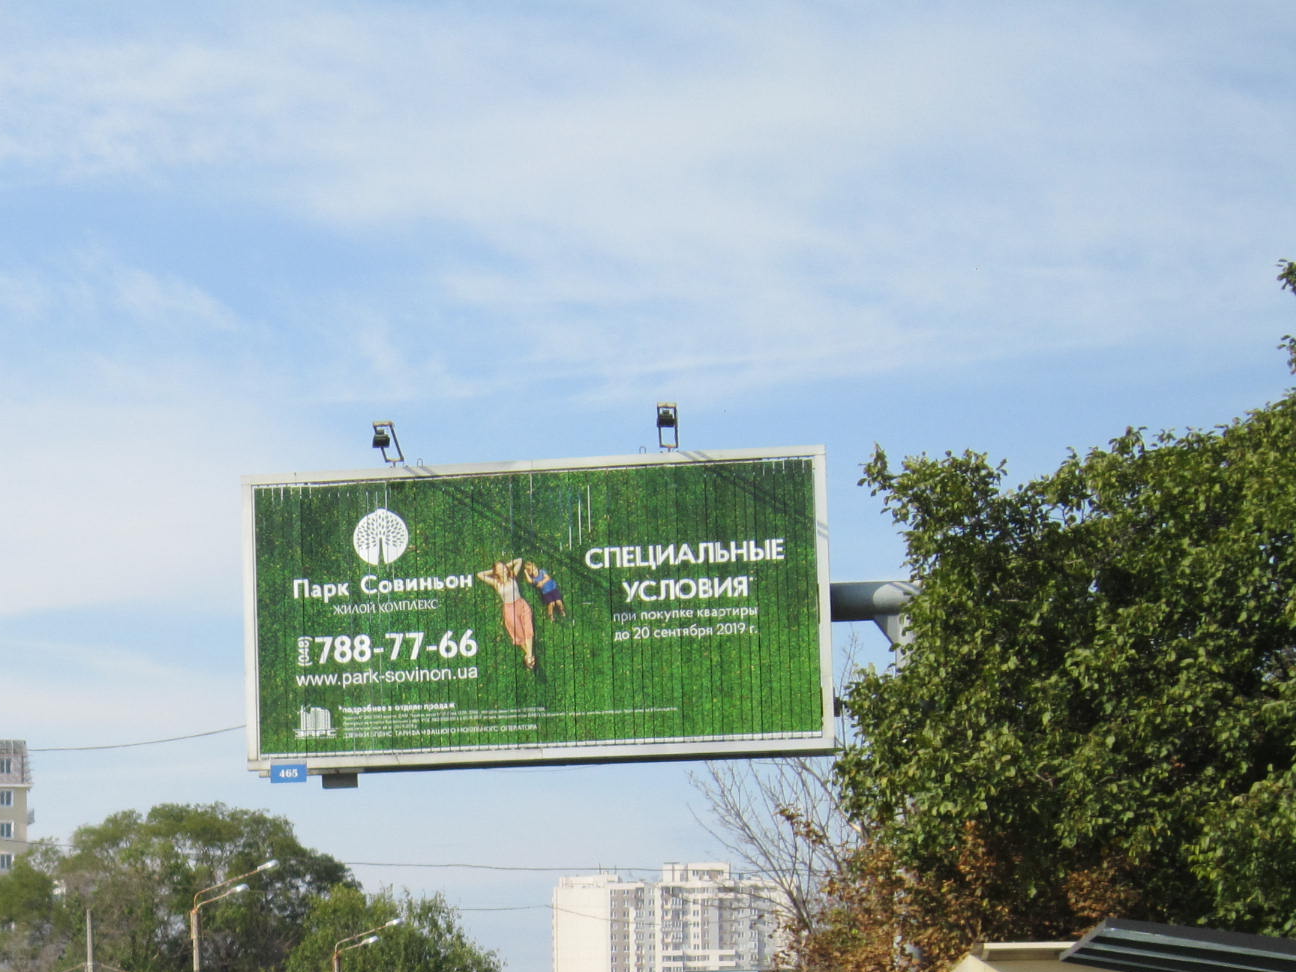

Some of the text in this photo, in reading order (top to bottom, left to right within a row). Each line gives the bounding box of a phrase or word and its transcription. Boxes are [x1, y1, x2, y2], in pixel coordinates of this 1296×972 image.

[585, 538, 785, 570] СПЕЦИАЛЬНЫЕ
[293, 573, 474, 603] Парк Совиньон
[333, 599, 439, 615] ЖИЛОЙ КОМПЛЕКС
[613, 605, 759, 624] при покупке квартиры
[614, 623, 759, 641] до 20 сентября 2019 г.
[315, 629, 479, 664] 788-77-66
[296, 667, 479, 688] www.park-sovinon.ua
[279, 768, 298, 777] 465
